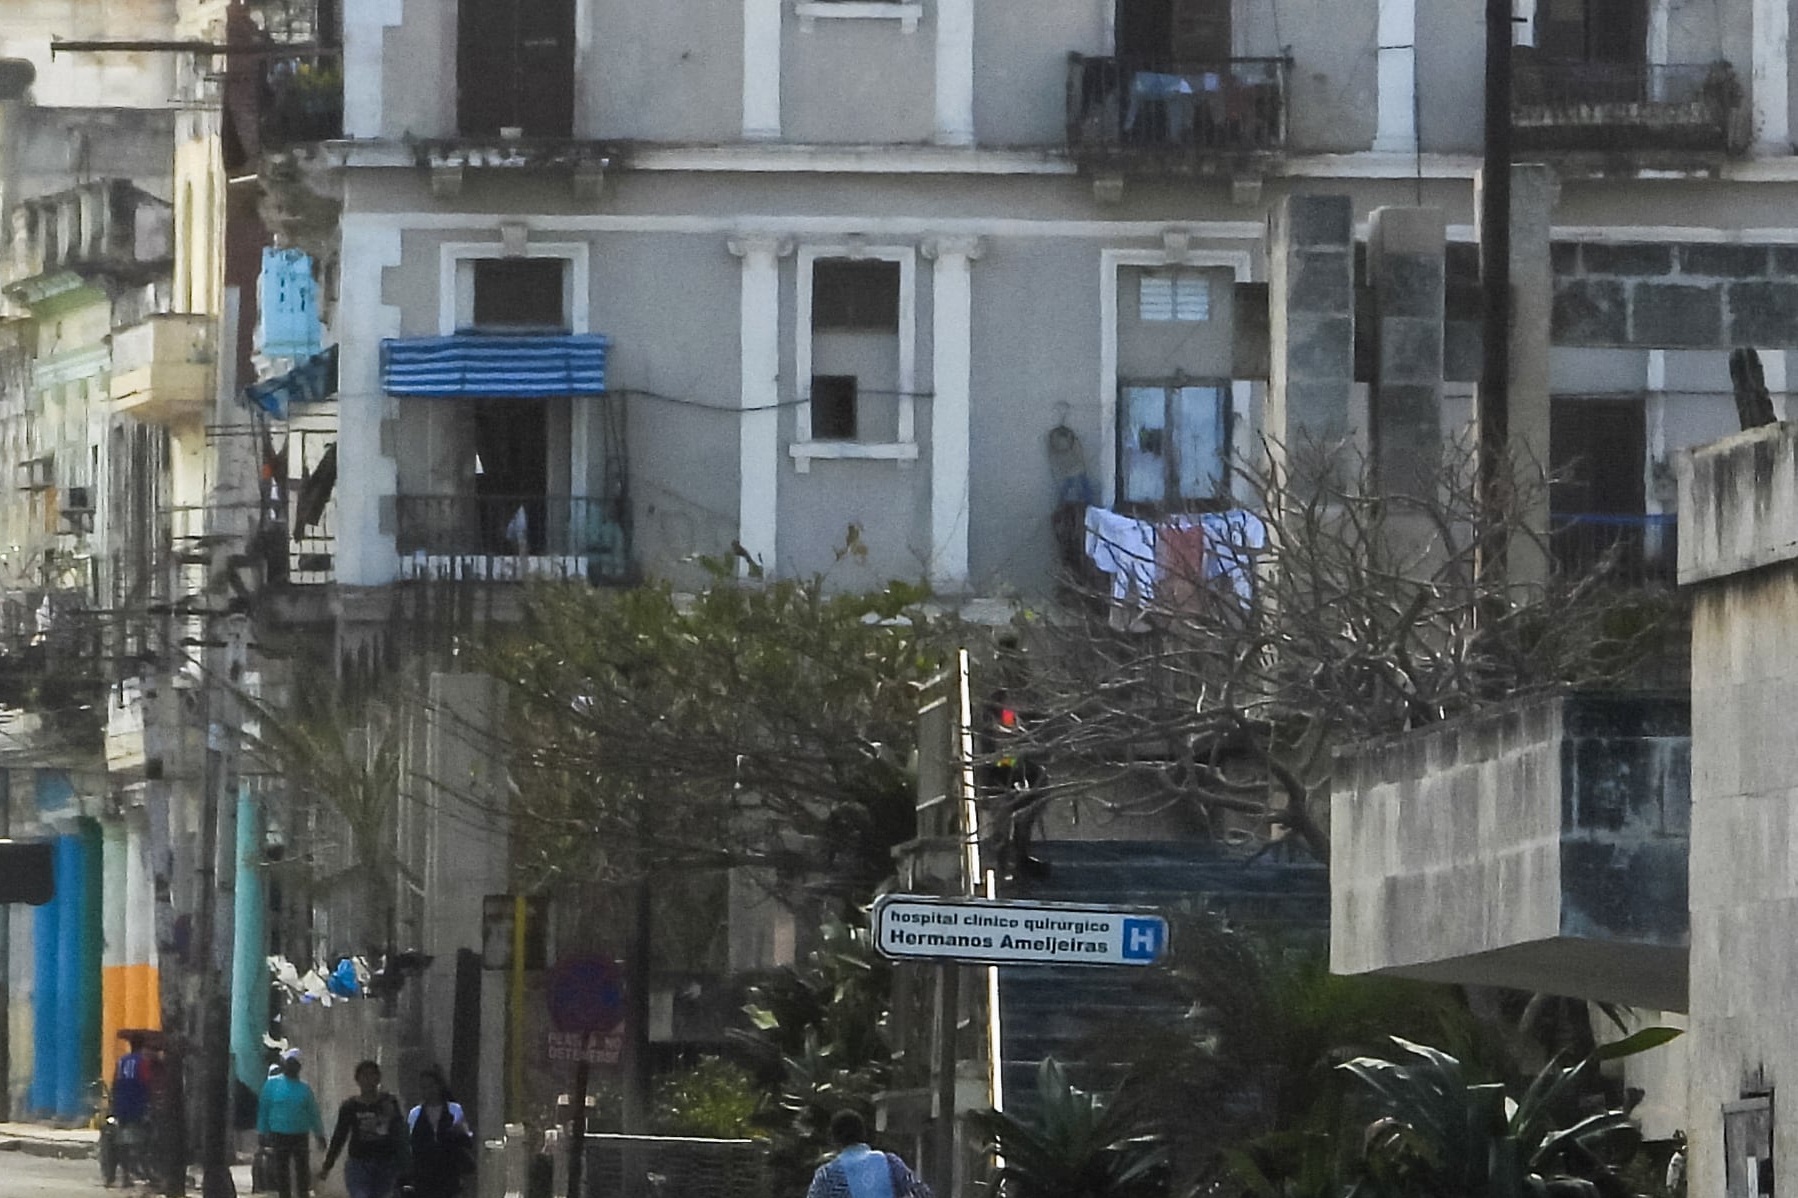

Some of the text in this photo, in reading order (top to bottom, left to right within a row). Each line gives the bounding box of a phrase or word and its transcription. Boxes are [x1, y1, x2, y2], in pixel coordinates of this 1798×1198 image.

[890, 910, 958, 927] hospital
[890, 929, 993, 948] Hermanos
[1130, 927, 1155, 952] H
